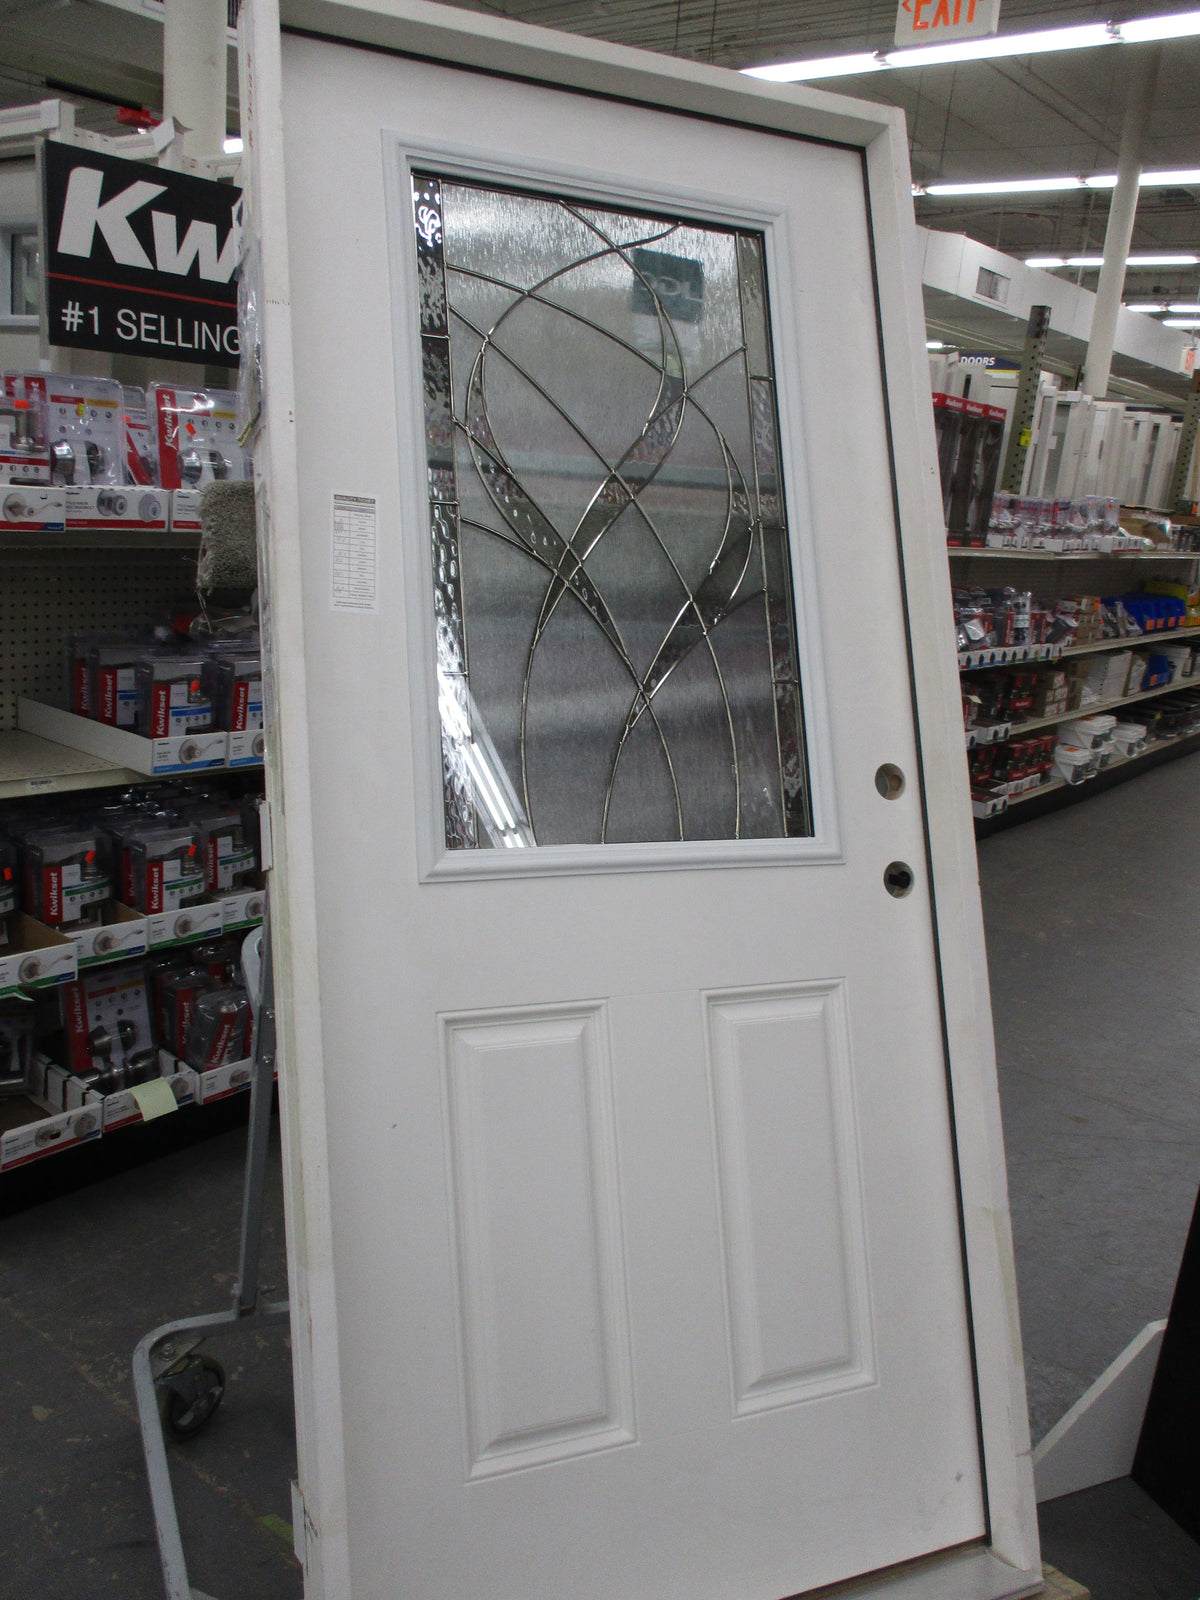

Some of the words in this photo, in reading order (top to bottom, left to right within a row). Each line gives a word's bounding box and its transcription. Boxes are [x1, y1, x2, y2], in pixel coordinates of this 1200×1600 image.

[61, 300, 100, 335] #1
[116, 308, 241, 355] SELLING
[959, 356, 996, 366] DOORS
[105, 673, 113, 719] Kwikset
[156, 690, 167, 736] Kwikset
[236, 687, 246, 731] Kwikset
[49, 871, 58, 916] Kwikset
[151, 866, 160, 910] Kwikset
[72, 987, 84, 1033] Kwikset
[211, 1024, 231, 1064] Kwikset
